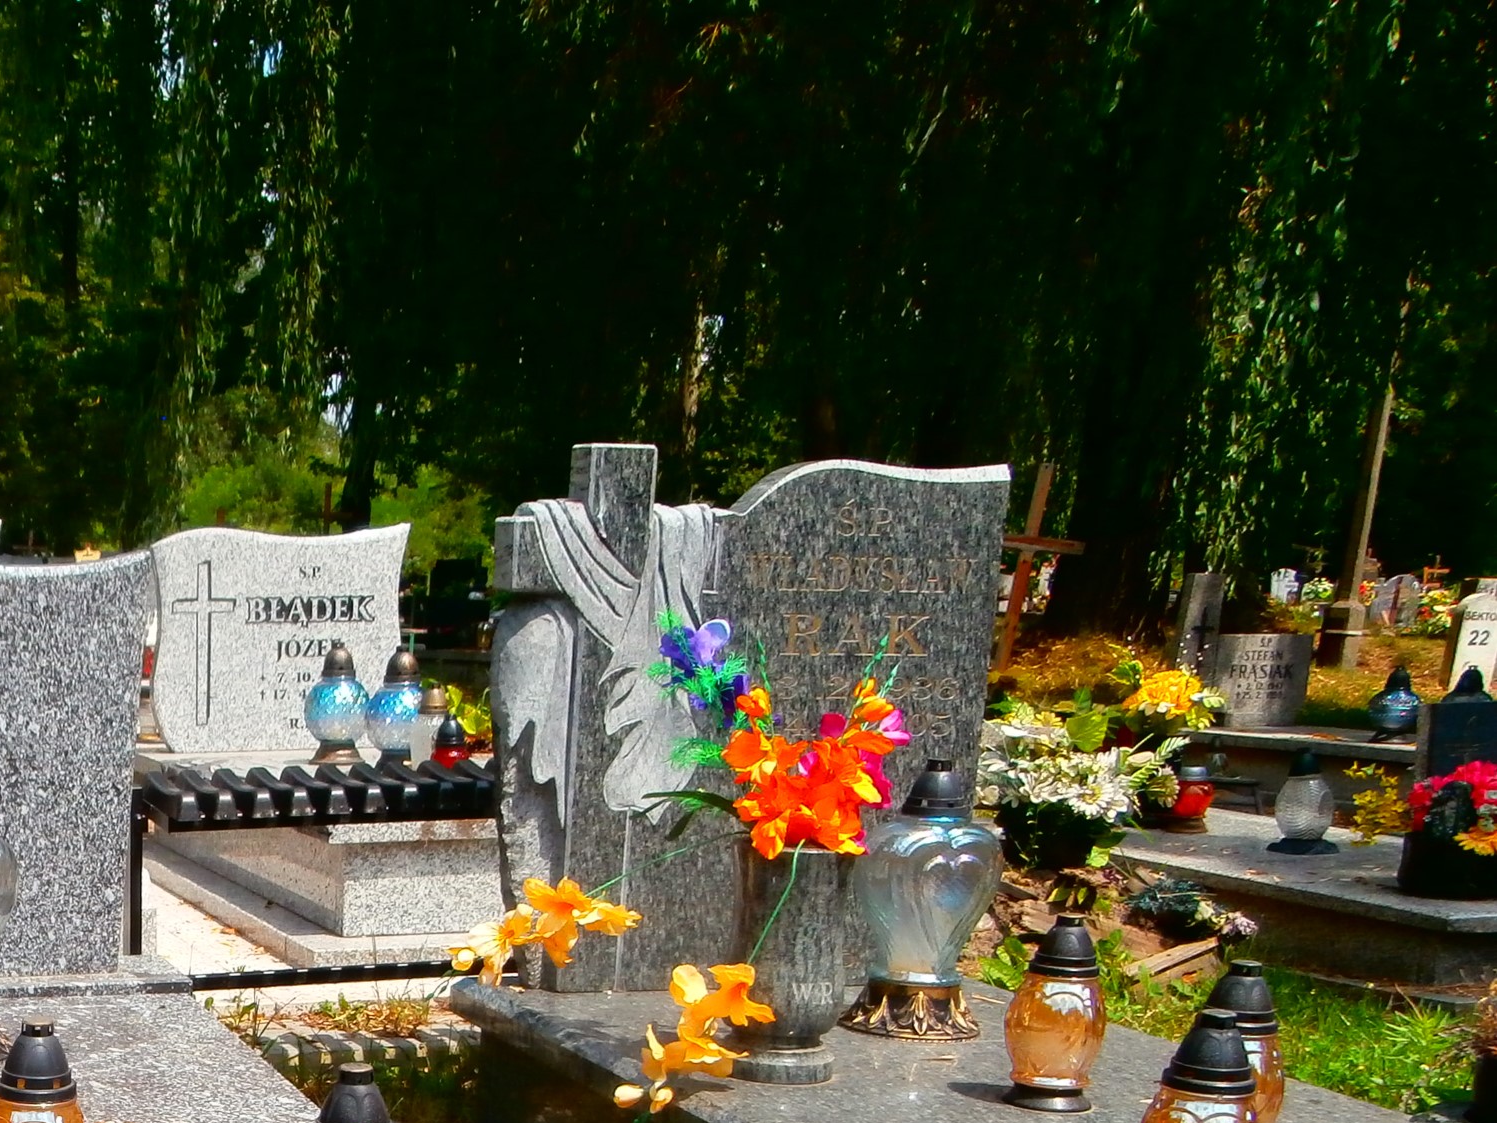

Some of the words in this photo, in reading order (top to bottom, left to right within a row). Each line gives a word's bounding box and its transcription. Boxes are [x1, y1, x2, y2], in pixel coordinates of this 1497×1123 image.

[779, 612, 931, 657] RAK
[1467, 629, 1491, 647] 22
[1243, 650, 1284, 661] STEFAN
